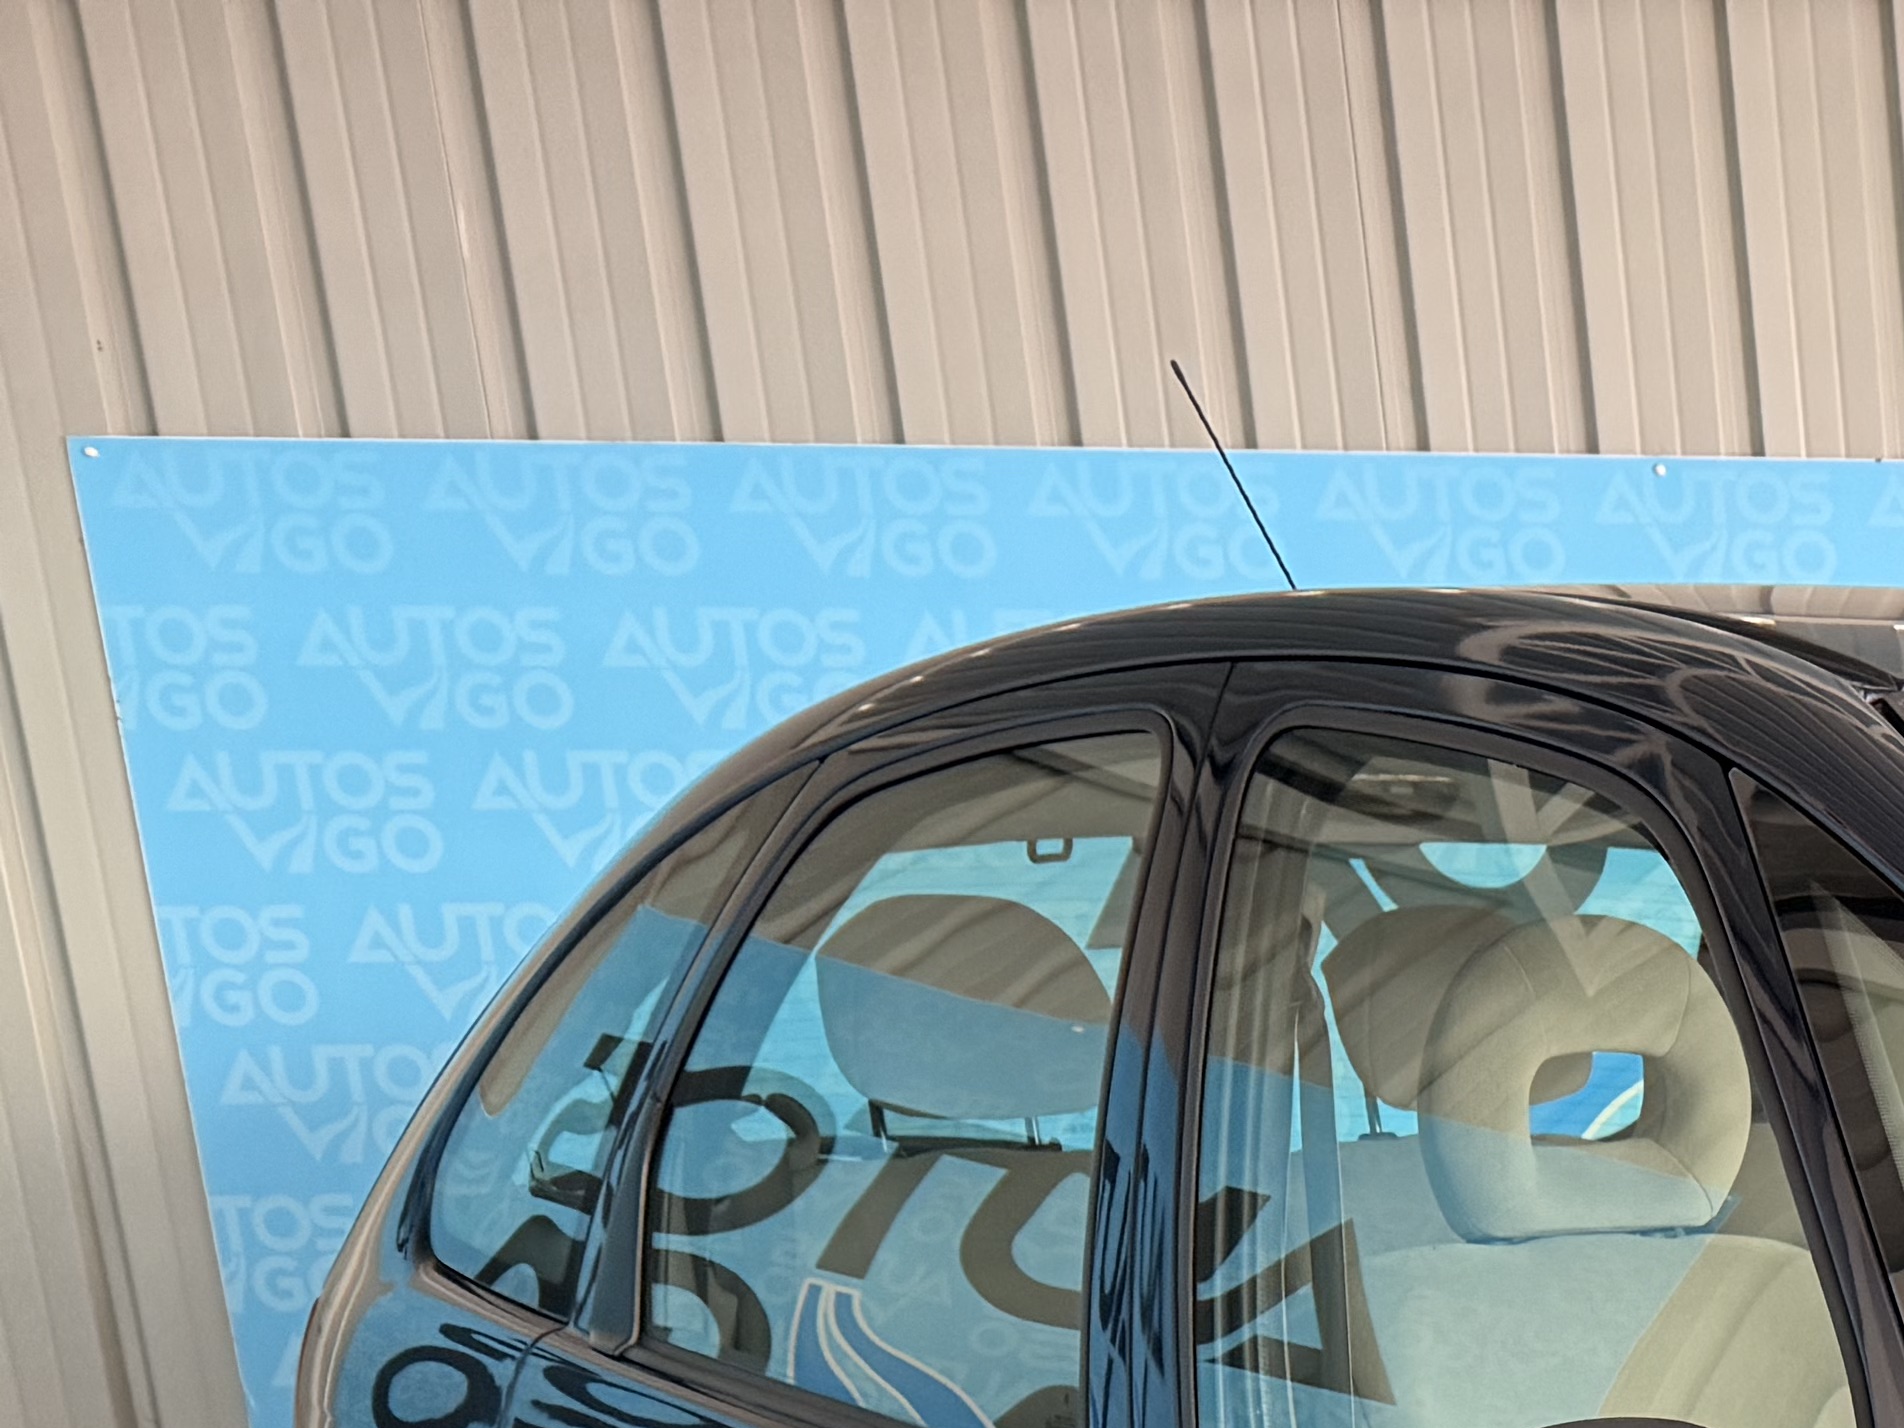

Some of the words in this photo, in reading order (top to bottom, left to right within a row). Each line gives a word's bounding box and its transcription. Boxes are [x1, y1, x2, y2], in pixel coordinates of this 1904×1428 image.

[112, 449, 386, 510] AUTOS
[423, 453, 697, 514] AUTOS
[730, 455, 986, 516] AUTOS
[1025, 460, 1281, 519] AUTOS
[1315, 464, 1562, 523] AUTOS
[1595, 467, 1832, 526] AUTOS
[171, 510, 395, 575] VIGO
[483, 513, 703, 578] VIGO
[782, 515, 997, 580] VIGO
[1078, 517, 1279, 582] VIGO
[1366, 520, 1566, 584] VIGO
[1638, 523, 1838, 584] VIGO
[297, 606, 566, 668] AUTOS
[603, 607, 868, 669] AUTOS
[356, 668, 575, 732] VIGO
[167, 750, 434, 811] AUTOS
[221, 811, 446, 874] VIGO
